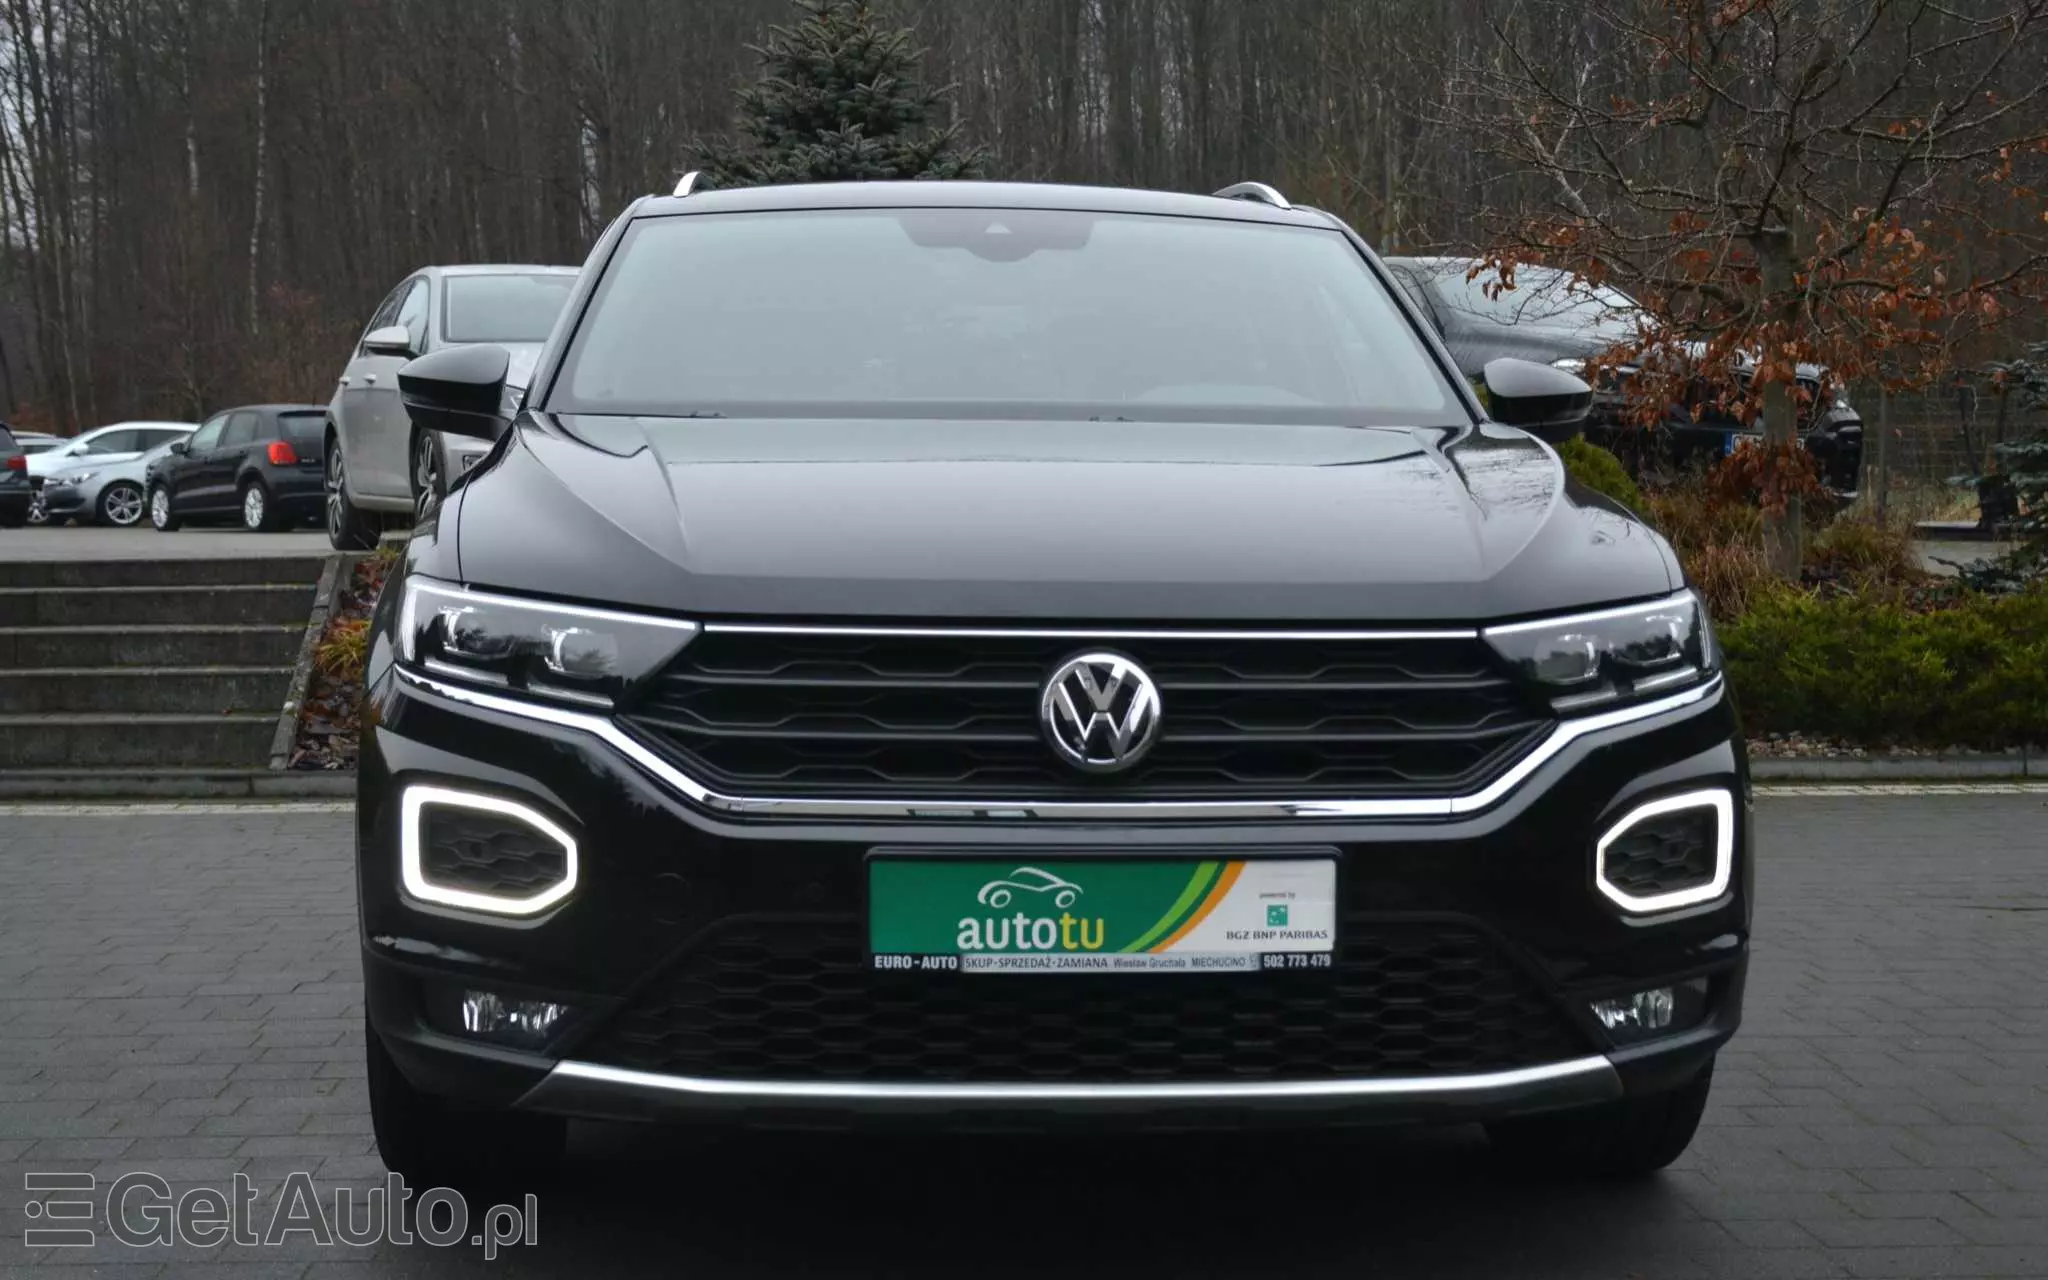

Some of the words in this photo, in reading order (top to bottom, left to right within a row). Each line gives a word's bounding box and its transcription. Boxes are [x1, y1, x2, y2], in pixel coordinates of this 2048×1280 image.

[1288, 891, 1296, 900] by
[957, 911, 1105, 950] autotu
[1253, 930, 1277, 939] BNP
[1280, 929, 1328, 939] PARIBAS
[1263, 954, 1284, 968] 502
[1288, 954, 1307, 968] 773
[1310, 954, 1331, 967] 479
